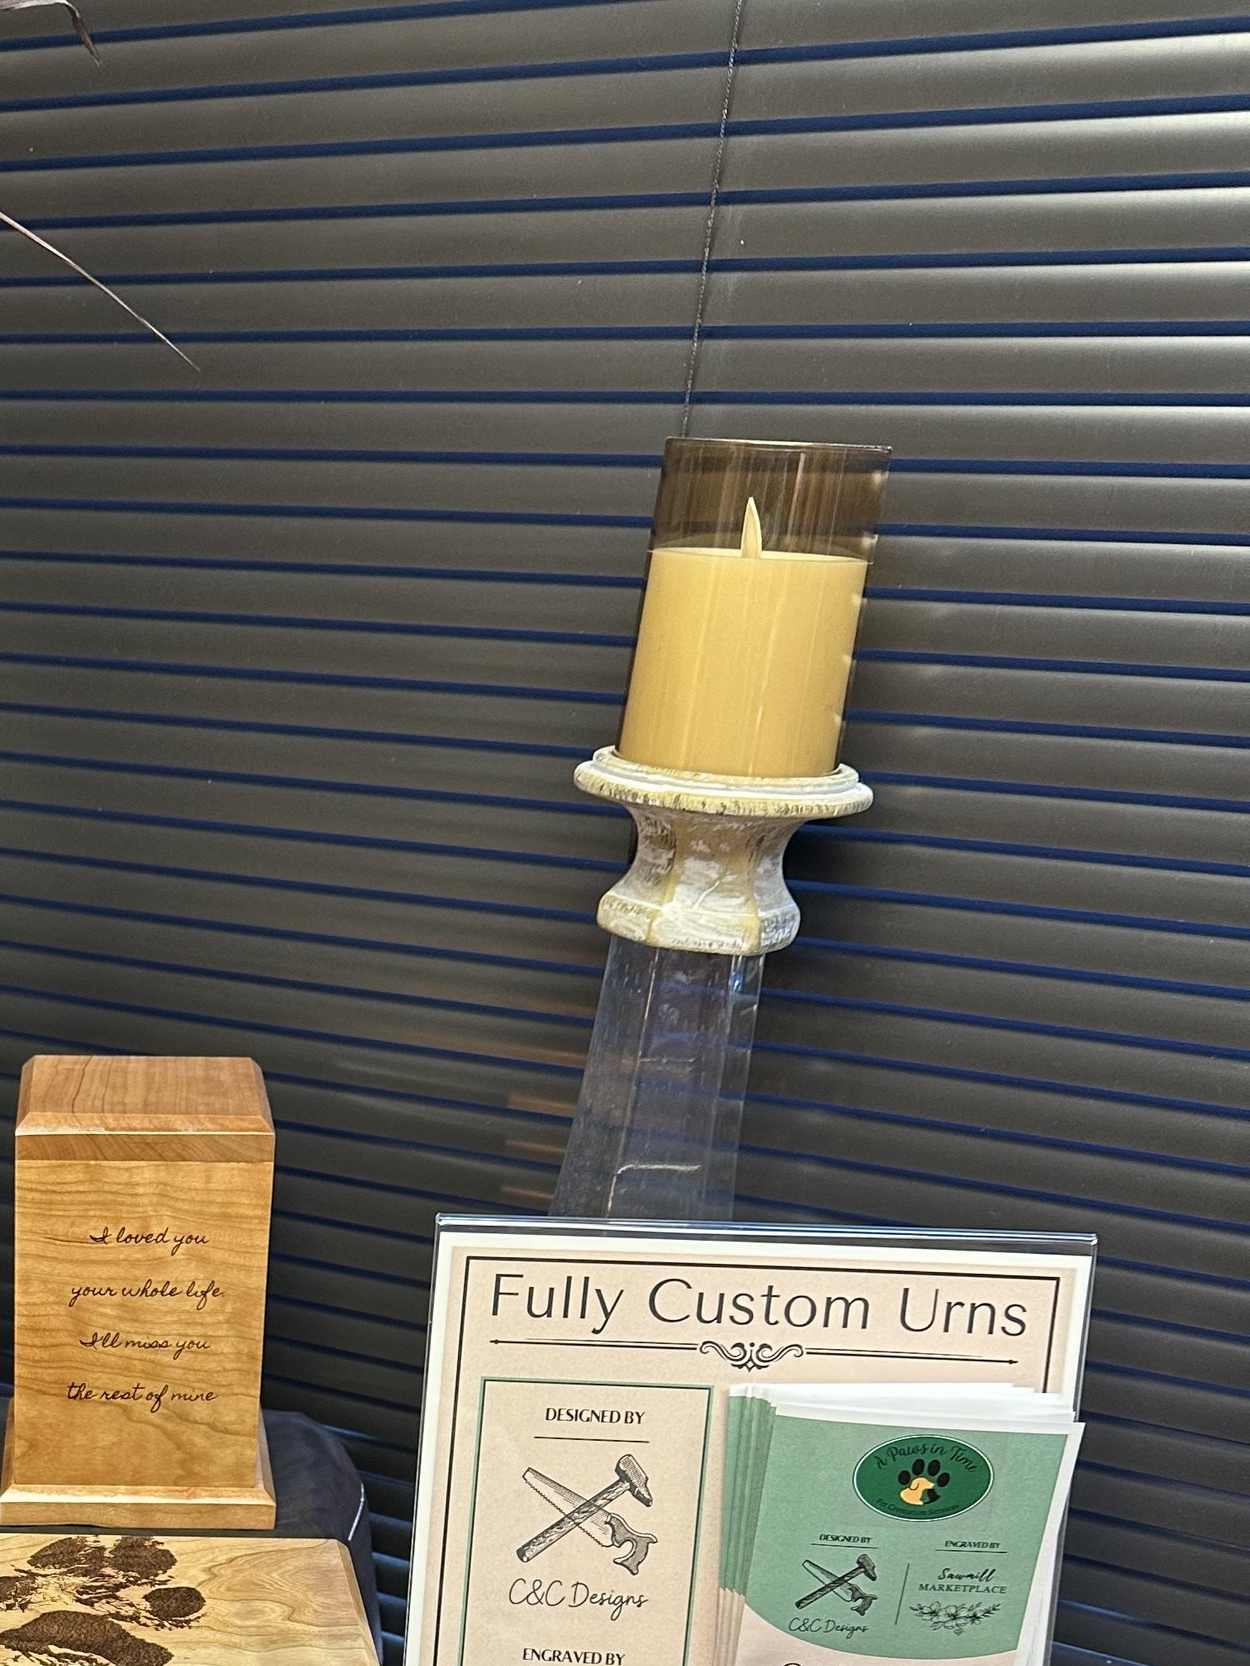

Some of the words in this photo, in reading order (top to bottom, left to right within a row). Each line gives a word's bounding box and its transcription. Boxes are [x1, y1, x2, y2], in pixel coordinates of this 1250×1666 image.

[116, 1227, 170, 1244] loved
[171, 1234, 209, 1256] you
[68, 1286, 118, 1307] your
[122, 1279, 182, 1298] whole
[491, 1273, 625, 1334] Fully
[649, 1278, 871, 1329] Custom
[899, 1287, 1027, 1336] Urns
[79, 1332, 122, 1349] I'll
[125, 1338, 172, 1348] miss
[173, 1340, 210, 1360] you
[66, 1382, 98, 1400] the
[100, 1383, 146, 1400] rest
[146, 1385, 168, 1413] of
[171, 1390, 218, 1402] mine
[545, 1408, 620, 1423] DESIGNED
[624, 1411, 645, 1425] BY
[888, 1444, 930, 1462] Paws
[930, 1445, 947, 1454] in
[950, 1446, 977, 1472] Time
[820, 1534, 859, 1543] DESIGNED
[508, 1578, 566, 1606] C&C
[568, 1582, 649, 1621] Designs
[918, 1584, 1007, 1594] MARKETPLACE
[788, 1617, 822, 1632] C&C
[823, 1620, 869, 1639] Designs
[522, 1648, 603, 1665] ENGRAVED
[606, 1652, 626, 1666] BY
